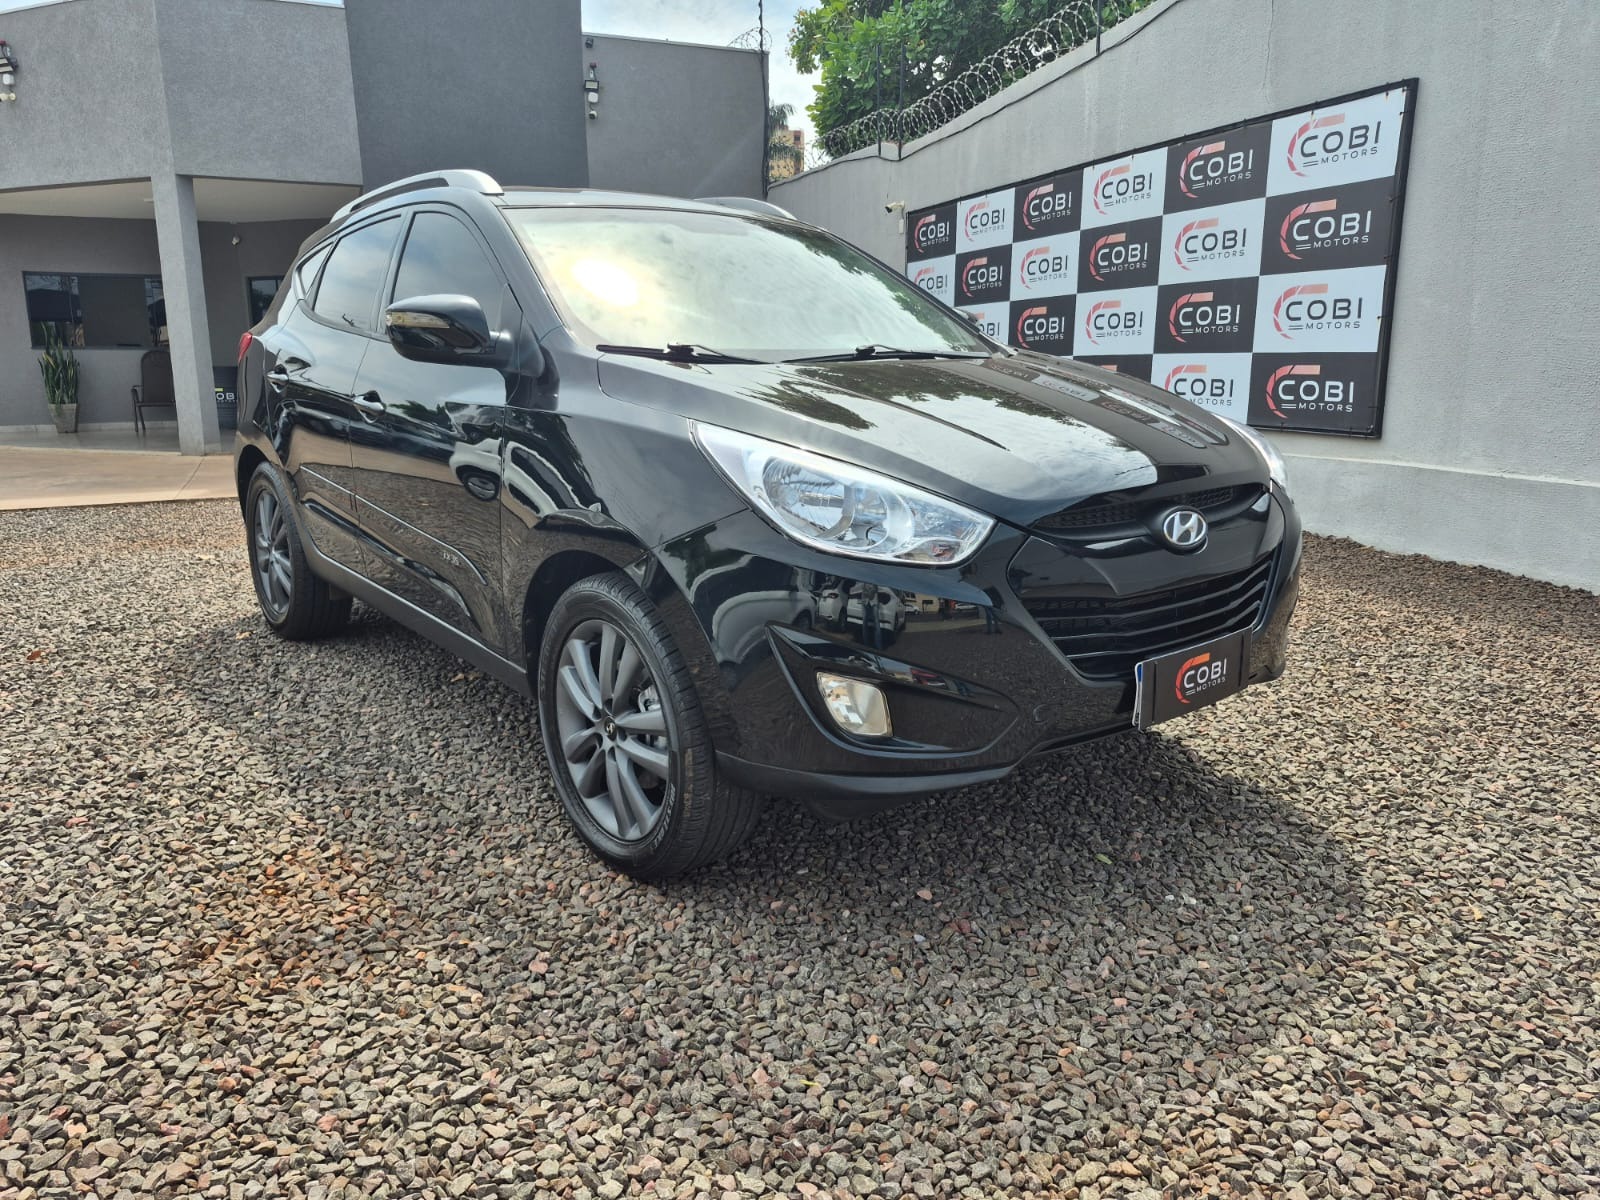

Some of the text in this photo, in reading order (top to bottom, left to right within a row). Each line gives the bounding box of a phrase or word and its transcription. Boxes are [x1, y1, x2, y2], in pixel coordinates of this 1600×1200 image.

[1301, 121, 1381, 158] COBI
[1321, 146, 1378, 164] MOTORS
[1190, 149, 1253, 181] COBI
[1102, 172, 1152, 199] COBI
[1206, 172, 1252, 186] MOTORS
[1030, 192, 1071, 216] COBI
[1116, 192, 1151, 205] MOTORS
[970, 208, 1005, 229] COBI
[1041, 210, 1071, 221] MOTORS
[919, 223, 949, 241] COBI
[1293, 211, 1371, 240] COBI
[1185, 228, 1246, 254] COBI
[1314, 235, 1369, 248] MOTORS
[1097, 242, 1148, 266] COBI
[1201, 250, 1245, 260] MOTORS
[1027, 255, 1068, 275] COBI
[1111, 261, 1147, 272] MOTORS
[968, 265, 1002, 284] COBI
[1038, 273, 1067, 281] MOTORS
[978, 281, 1002, 289] MOTORS
[1179, 305, 1240, 326] COBI
[1286, 298, 1362, 321] COBI
[979, 322, 1000, 336] BI
[1024, 317, 1064, 334] COBI
[1094, 311, 1143, 330] COBI
[1306, 321, 1360, 330] MOTORS
[1107, 329, 1142, 337] MOTORS
[1195, 326, 1238, 334] MOTORS
[1174, 378, 1233, 398] COBI
[1278, 380, 1354, 403] COBI
[1299, 402, 1352, 412] MOTORS
[1184, 658, 1227, 688] COBI
[1196, 677, 1226, 692] MOTORS
